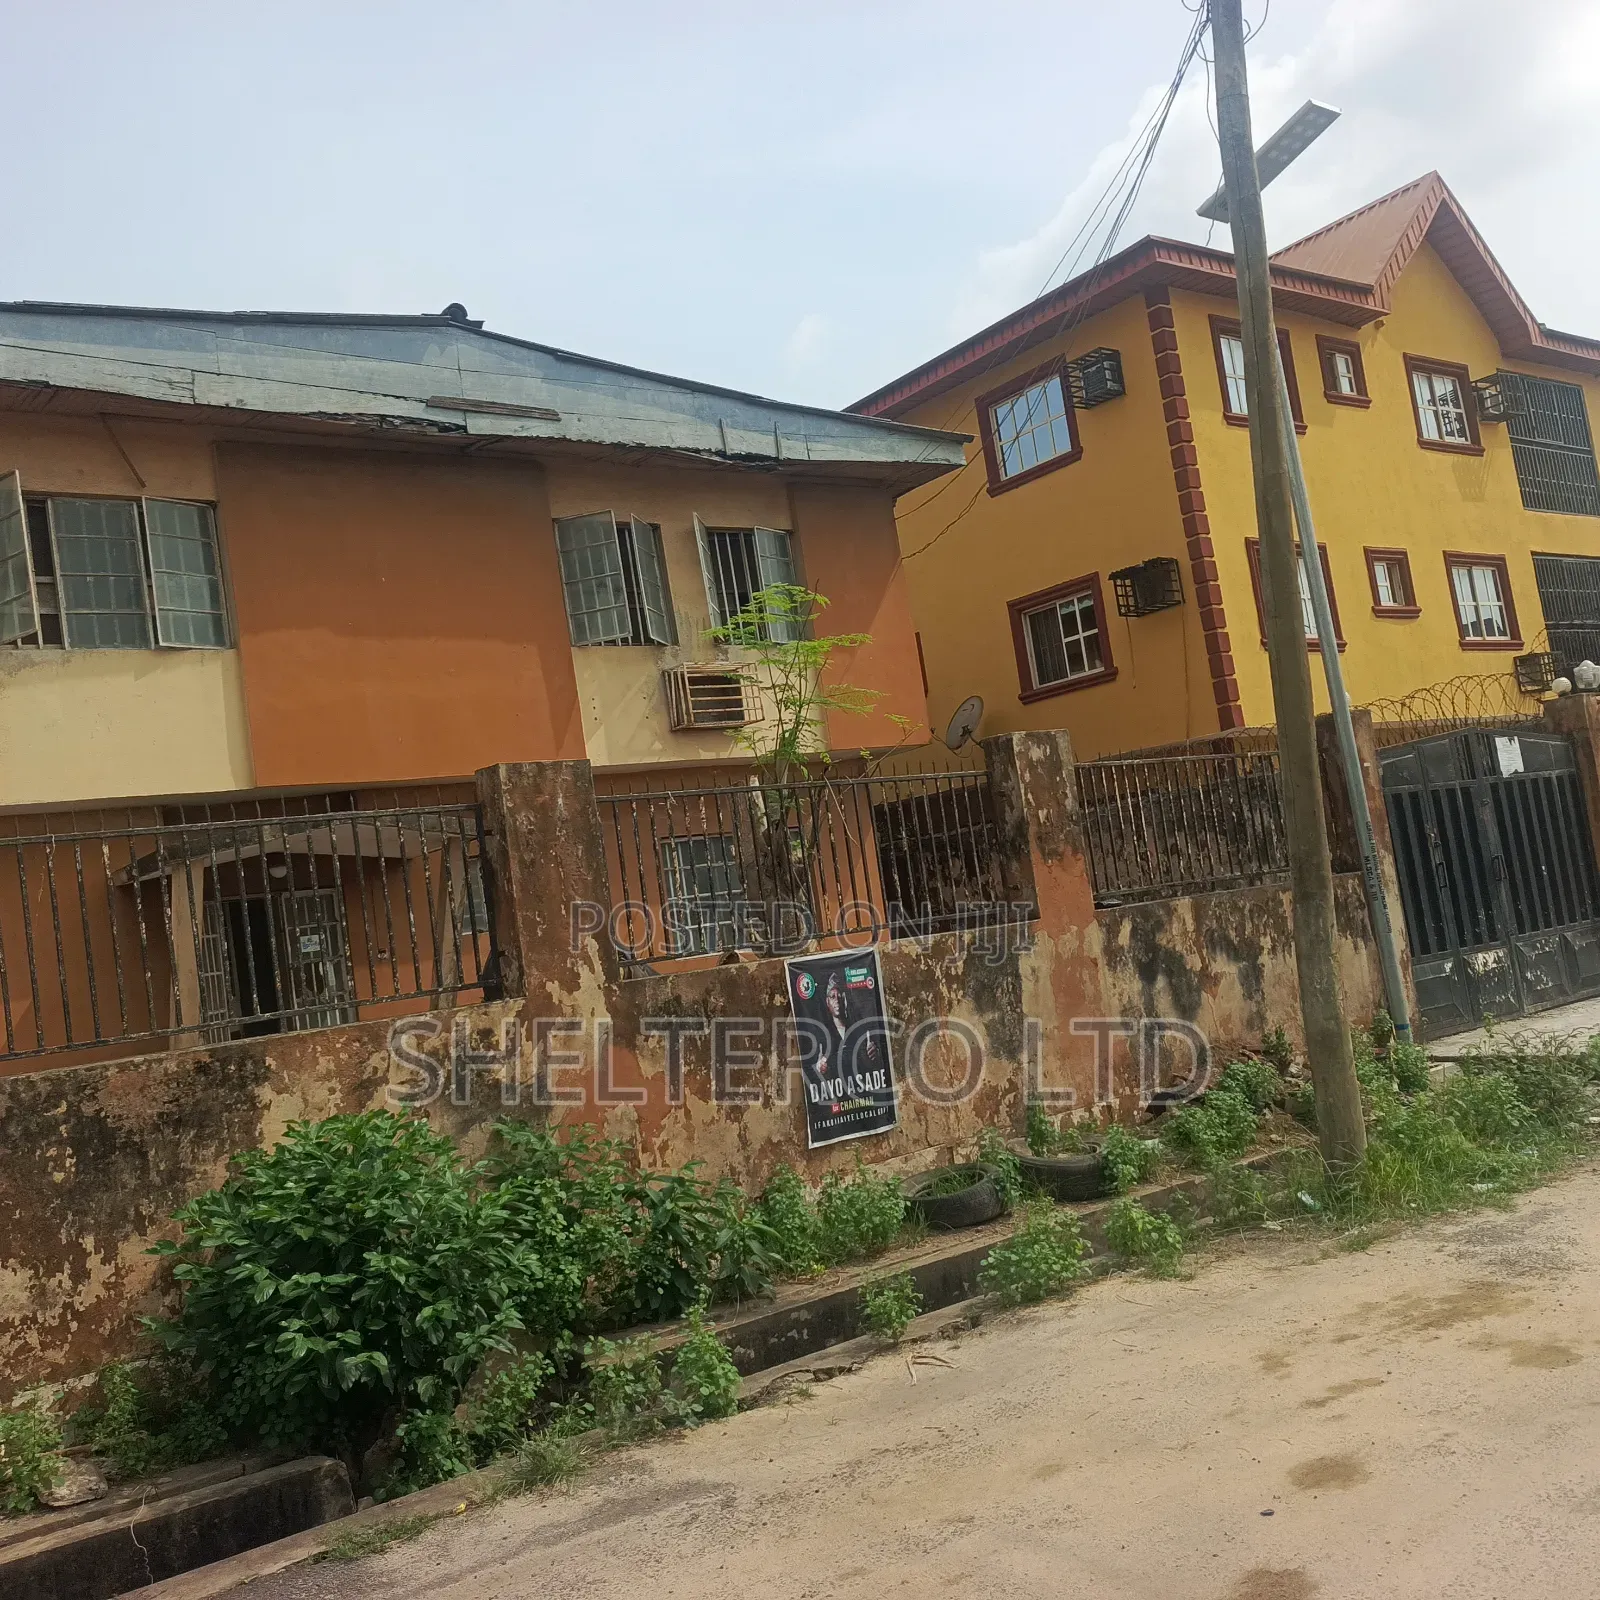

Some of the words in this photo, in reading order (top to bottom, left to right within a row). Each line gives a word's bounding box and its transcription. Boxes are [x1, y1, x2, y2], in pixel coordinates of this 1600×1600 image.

[810, 1078, 843, 1103] DAYO
[847, 1069, 887, 1095] ASADE
[841, 1096, 874, 1111] CHAIRMAN
[856, 1111, 876, 1120] LOCAL
